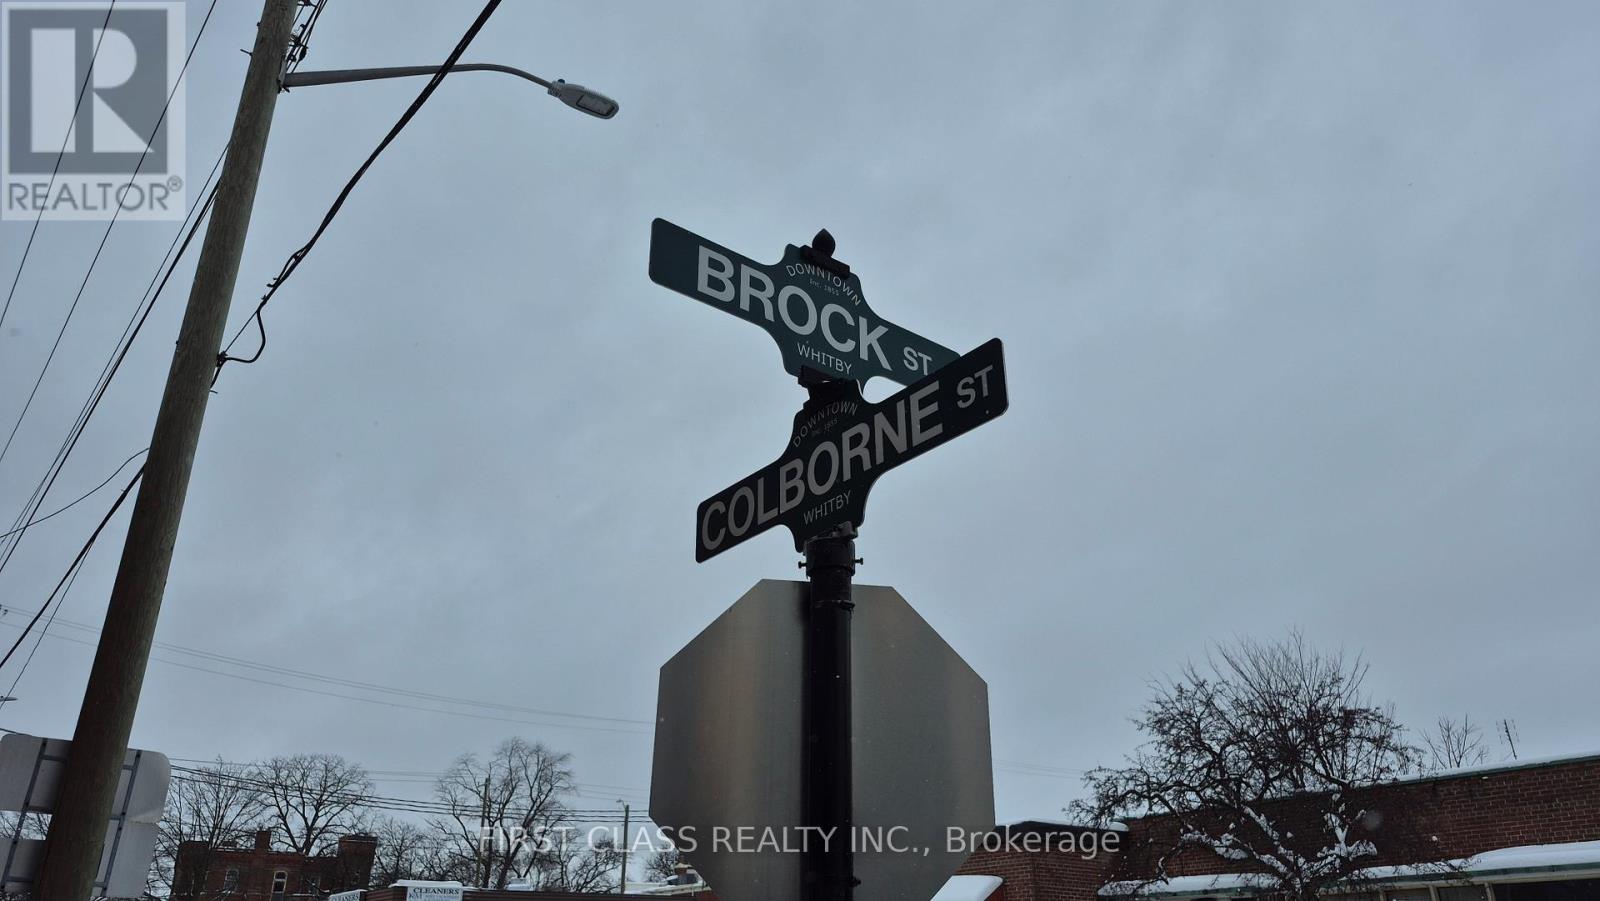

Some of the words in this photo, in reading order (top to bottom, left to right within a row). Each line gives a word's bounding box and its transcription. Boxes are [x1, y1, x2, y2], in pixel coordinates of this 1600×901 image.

[786, 263, 861, 306] DOWNTOWN
[697, 245, 893, 371] BROCK
[903, 346, 933, 376] ST
[797, 342, 852, 375] WHITBY
[792, 401, 858, 448] DOWNTOWN
[701, 380, 944, 551] COLBORNE
[956, 365, 994, 409] ST
[803, 489, 851, 526] WHITBY
[413, 887, 460, 895] CLEANERS
